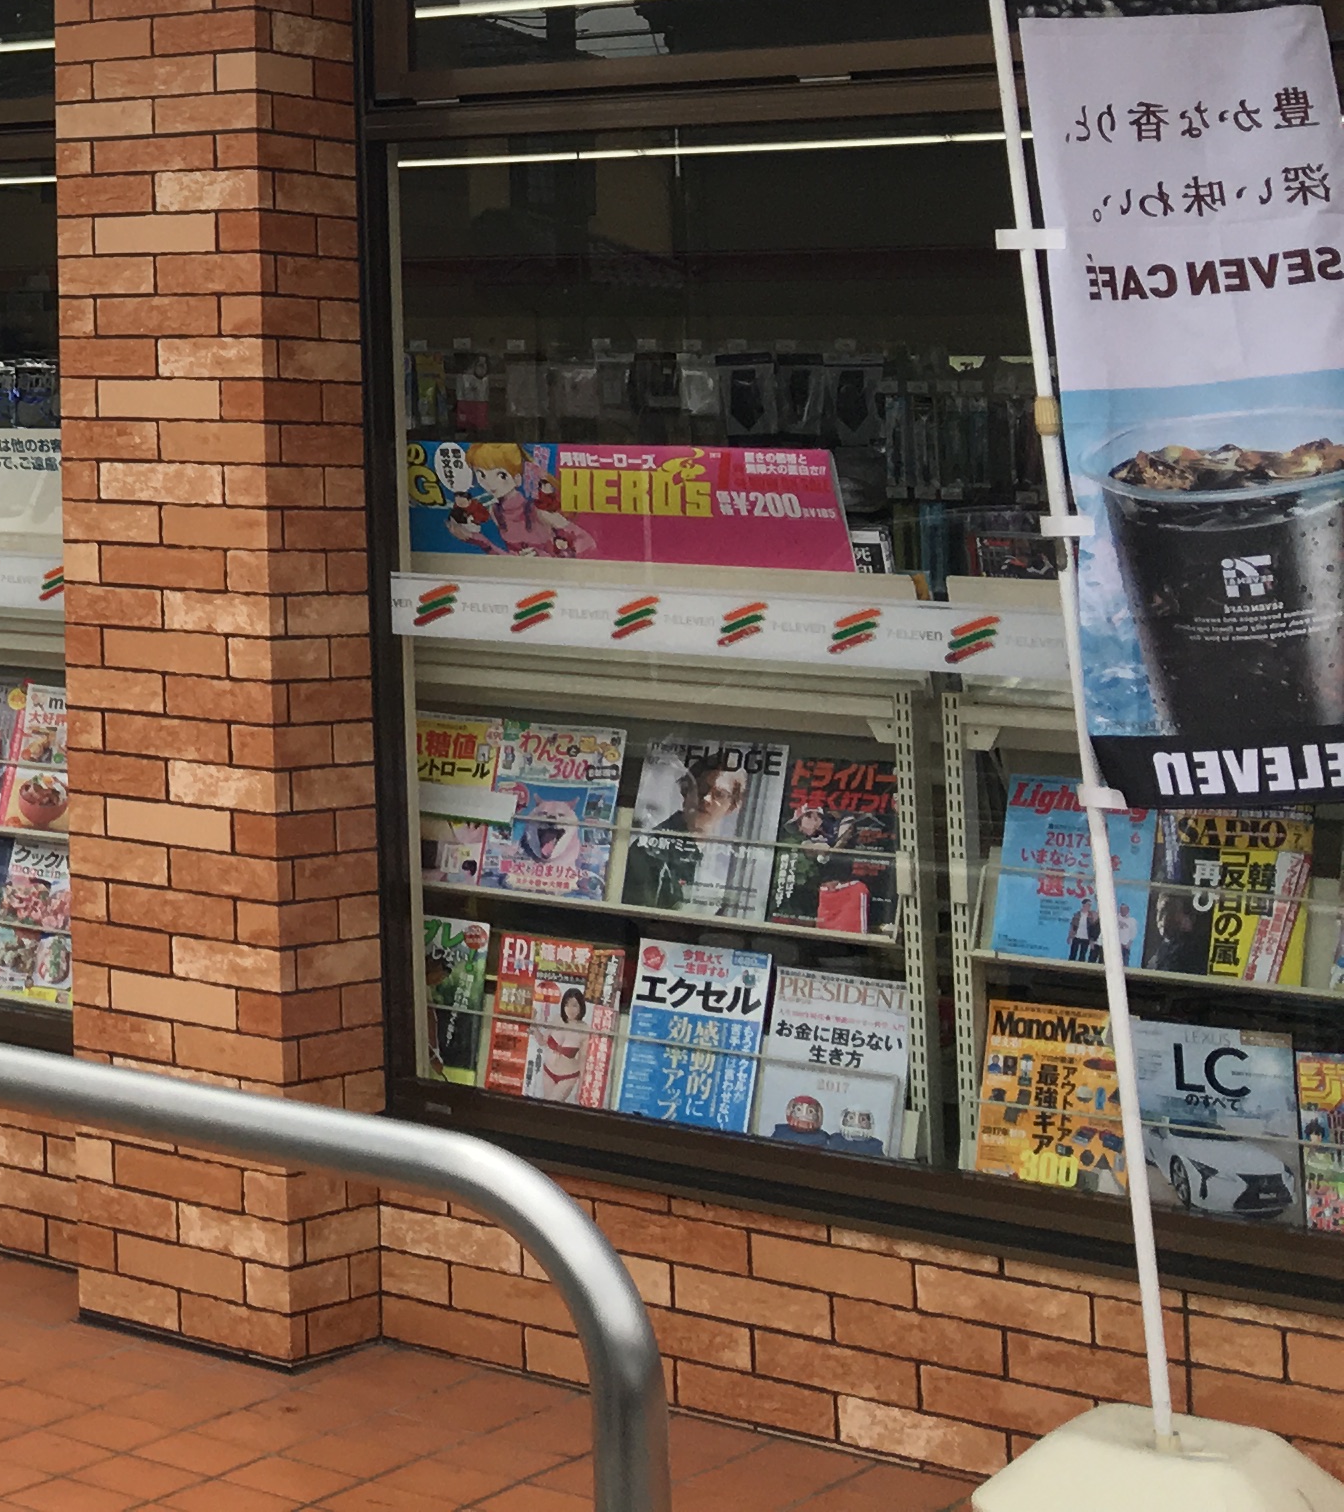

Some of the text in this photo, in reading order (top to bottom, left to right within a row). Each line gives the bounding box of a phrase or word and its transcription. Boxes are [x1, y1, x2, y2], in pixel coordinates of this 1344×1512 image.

[559, 451, 656, 469] 月刊ヒーローズ
[732, 490, 802, 519] ¥200
[417, 731, 478, 760] 糖値
[519, 731, 575, 763] わんこ
[685, 746, 784, 776] FUDGE
[789, 759, 898, 791] ドライバー
[789, 790, 891, 814] うまく打つ!
[1129, 832, 1142, 845] 6
[1177, 816, 1288, 849] SAPIO
[1021, 847, 1121, 872] いまならこを
[1245, 861, 1278, 918] 韓国
[636, 974, 763, 1016] エクセル
[779, 976, 906, 1011] PRESIDENT
[775, 1019, 904, 1052] お金に困らない
[993, 1010, 1108, 1046] MonoMax
[685, 1020, 719, 1117] 感動的に
[808, 1044, 864, 1069] 生き方
[1173, 1042, 1252, 1098] LC
[1031, 1063, 1060, 1155] 最強ギア
[1056, 1066, 1078, 1143] アウトドア
[1184, 1092, 1242, 1112] のすべて
[1018, 1148, 1080, 1189] 300
